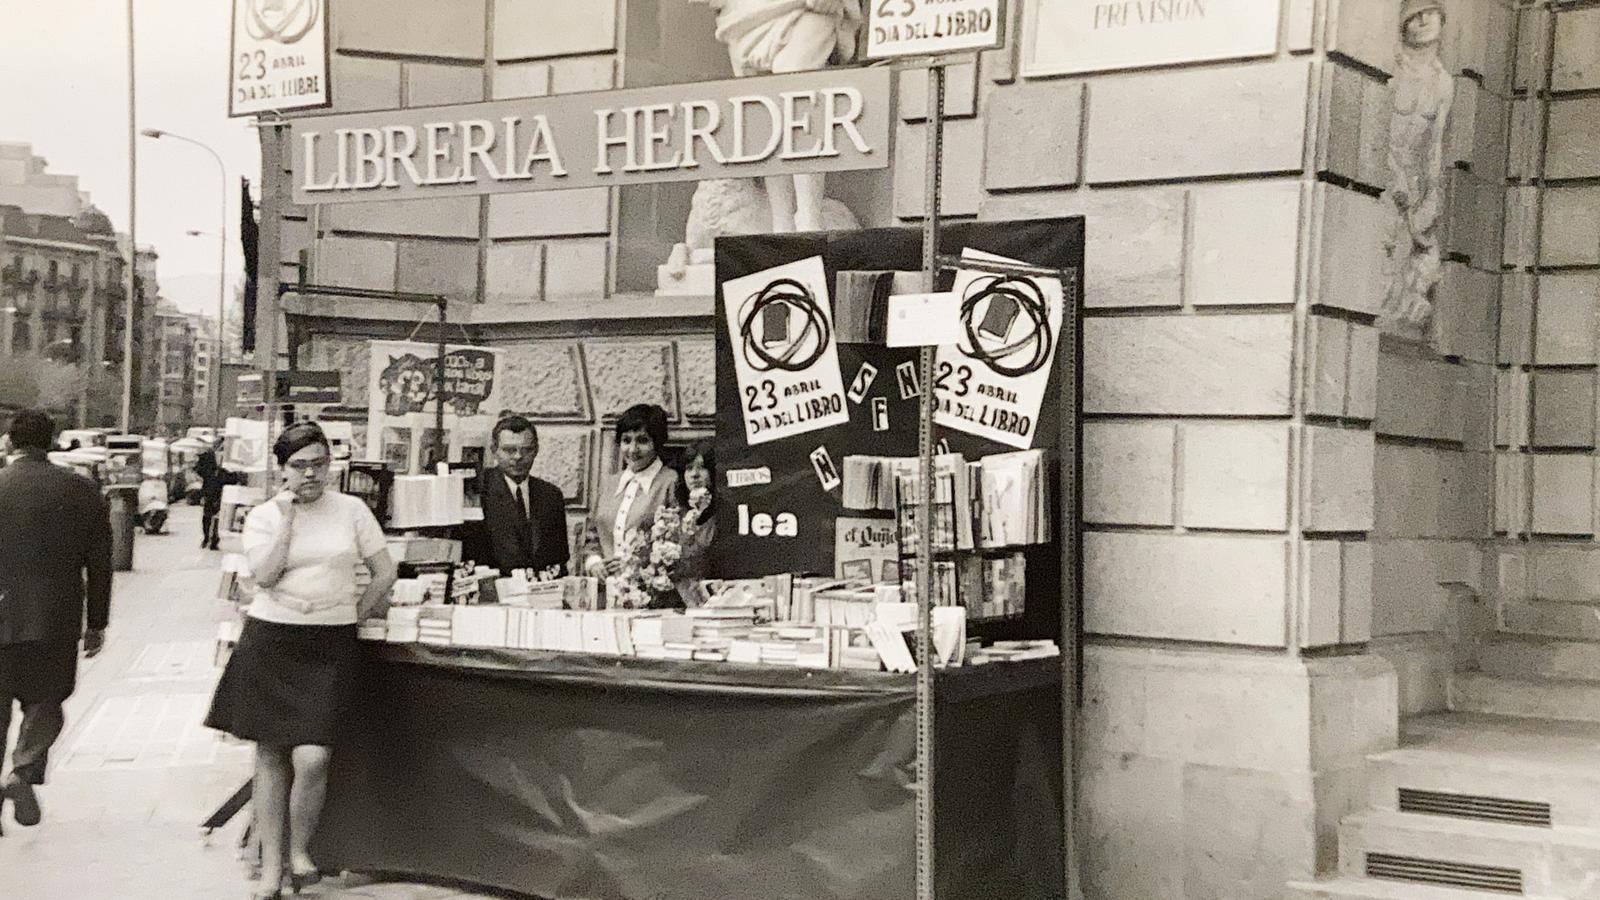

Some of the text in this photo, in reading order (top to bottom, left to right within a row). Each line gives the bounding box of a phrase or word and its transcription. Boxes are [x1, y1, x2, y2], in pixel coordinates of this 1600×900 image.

[933, 7, 991, 38] LIBRO
[238, 49, 306, 80] 23 ABRIL
[301, 85, 871, 191] LIBRERIA HERDER
[745, 378, 821, 412] 23 ABRIL
[935, 361, 1018, 404] 23 ABRIL
[749, 392, 842, 434] DIA DEL LIBRO
[979, 404, 1031, 437] LIBRO
[738, 504, 798, 537] lea
